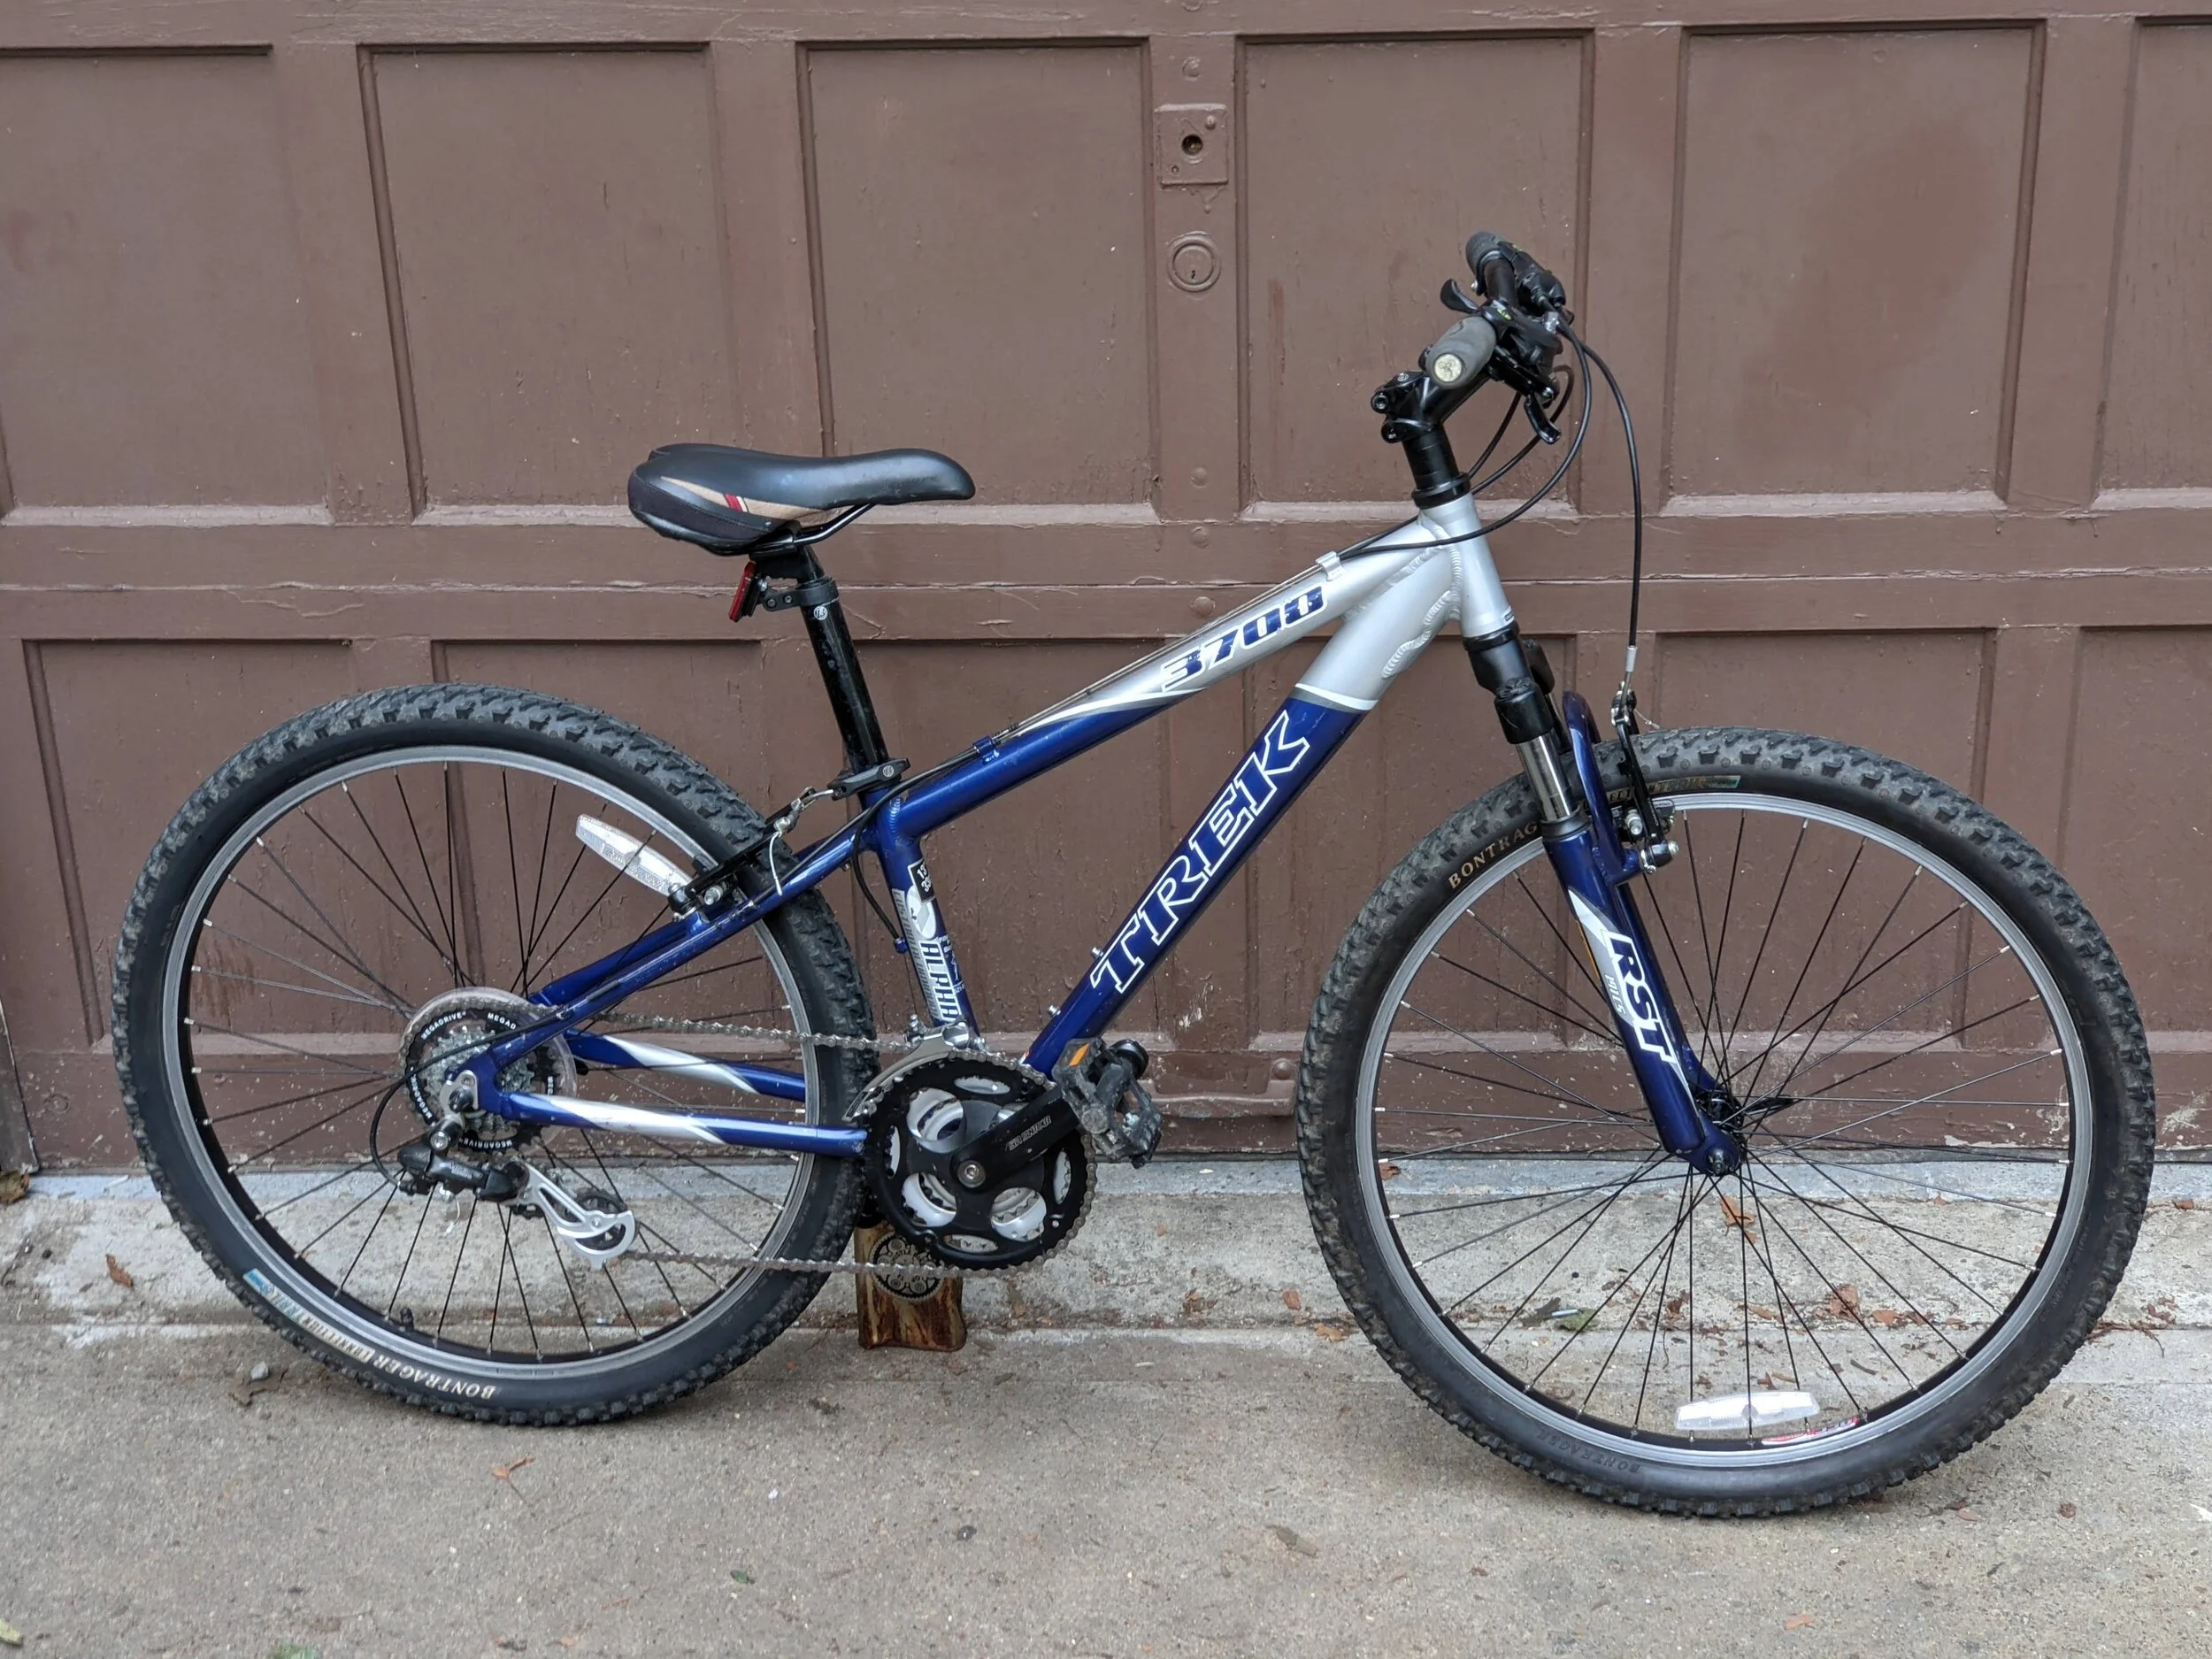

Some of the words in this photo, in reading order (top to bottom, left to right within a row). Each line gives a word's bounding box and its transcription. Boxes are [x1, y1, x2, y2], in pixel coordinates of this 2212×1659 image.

[1161, 585, 1327, 693] 3700
[1090, 709, 1310, 994] TREK
[1448, 824, 1538, 890] BONTRAG
[918, 941, 963, 1020] ALPHA
[1601, 929, 1678, 1063] RST
[488, 1012, 516, 1030] MEGAD
[373, 1353, 496, 1400] BONTRAGER
